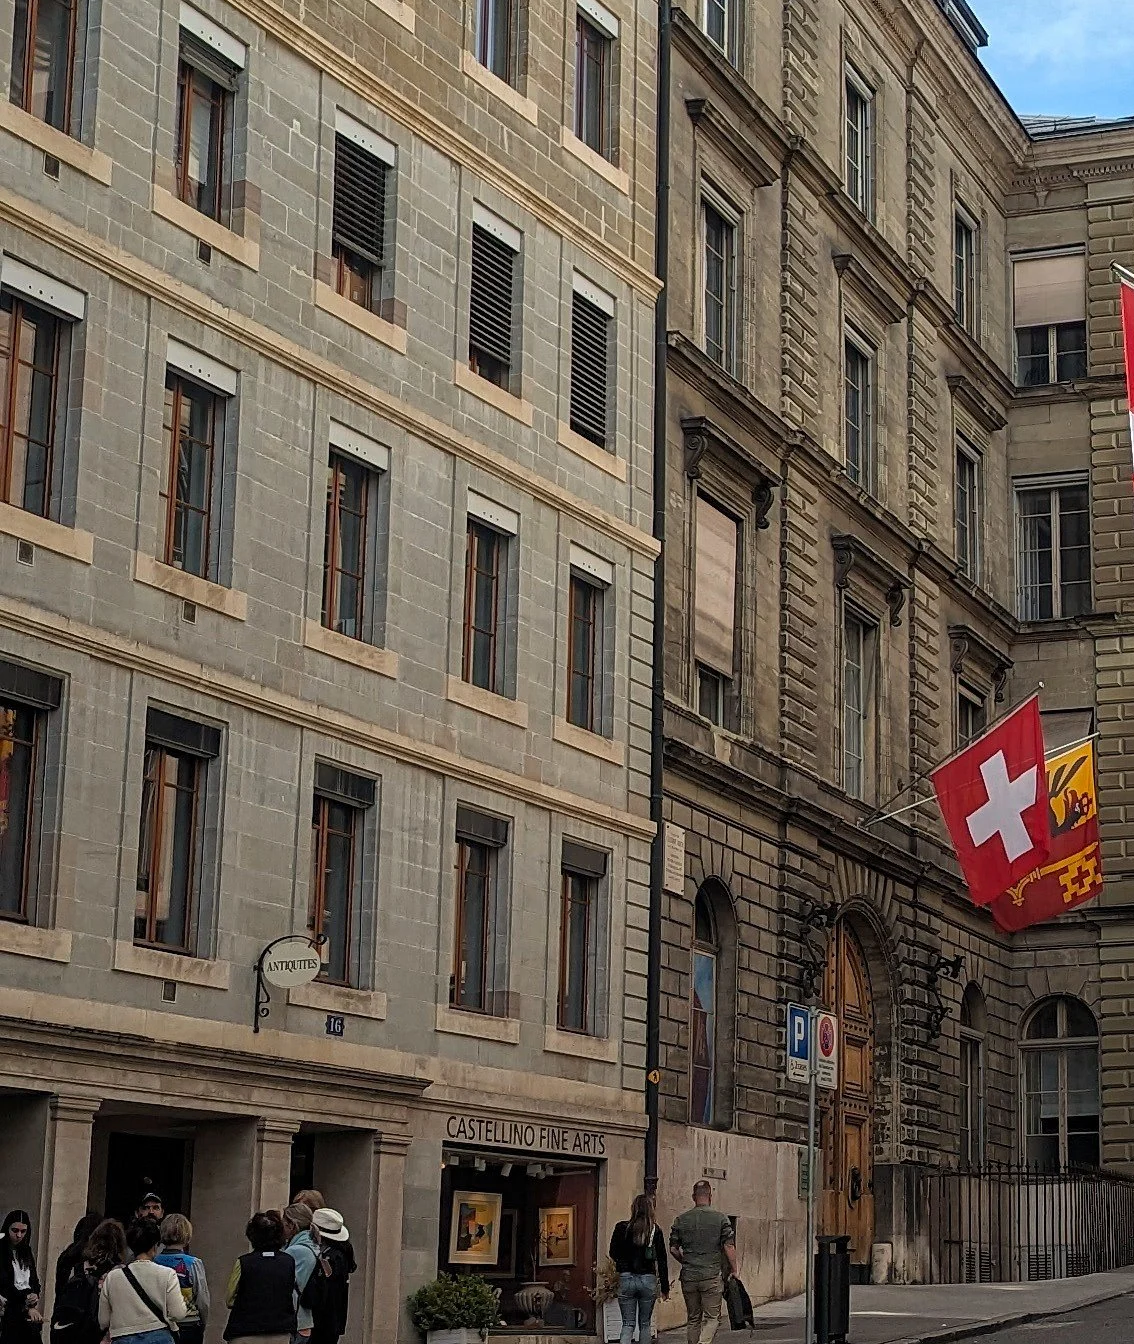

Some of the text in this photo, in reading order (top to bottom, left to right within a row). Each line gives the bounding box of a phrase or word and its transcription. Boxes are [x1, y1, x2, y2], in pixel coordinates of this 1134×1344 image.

[330, 1017, 342, 1033] 16
[794, 1015, 805, 1053] P
[446, 1115, 605, 1155] CASTELLINO FINE ARTS
